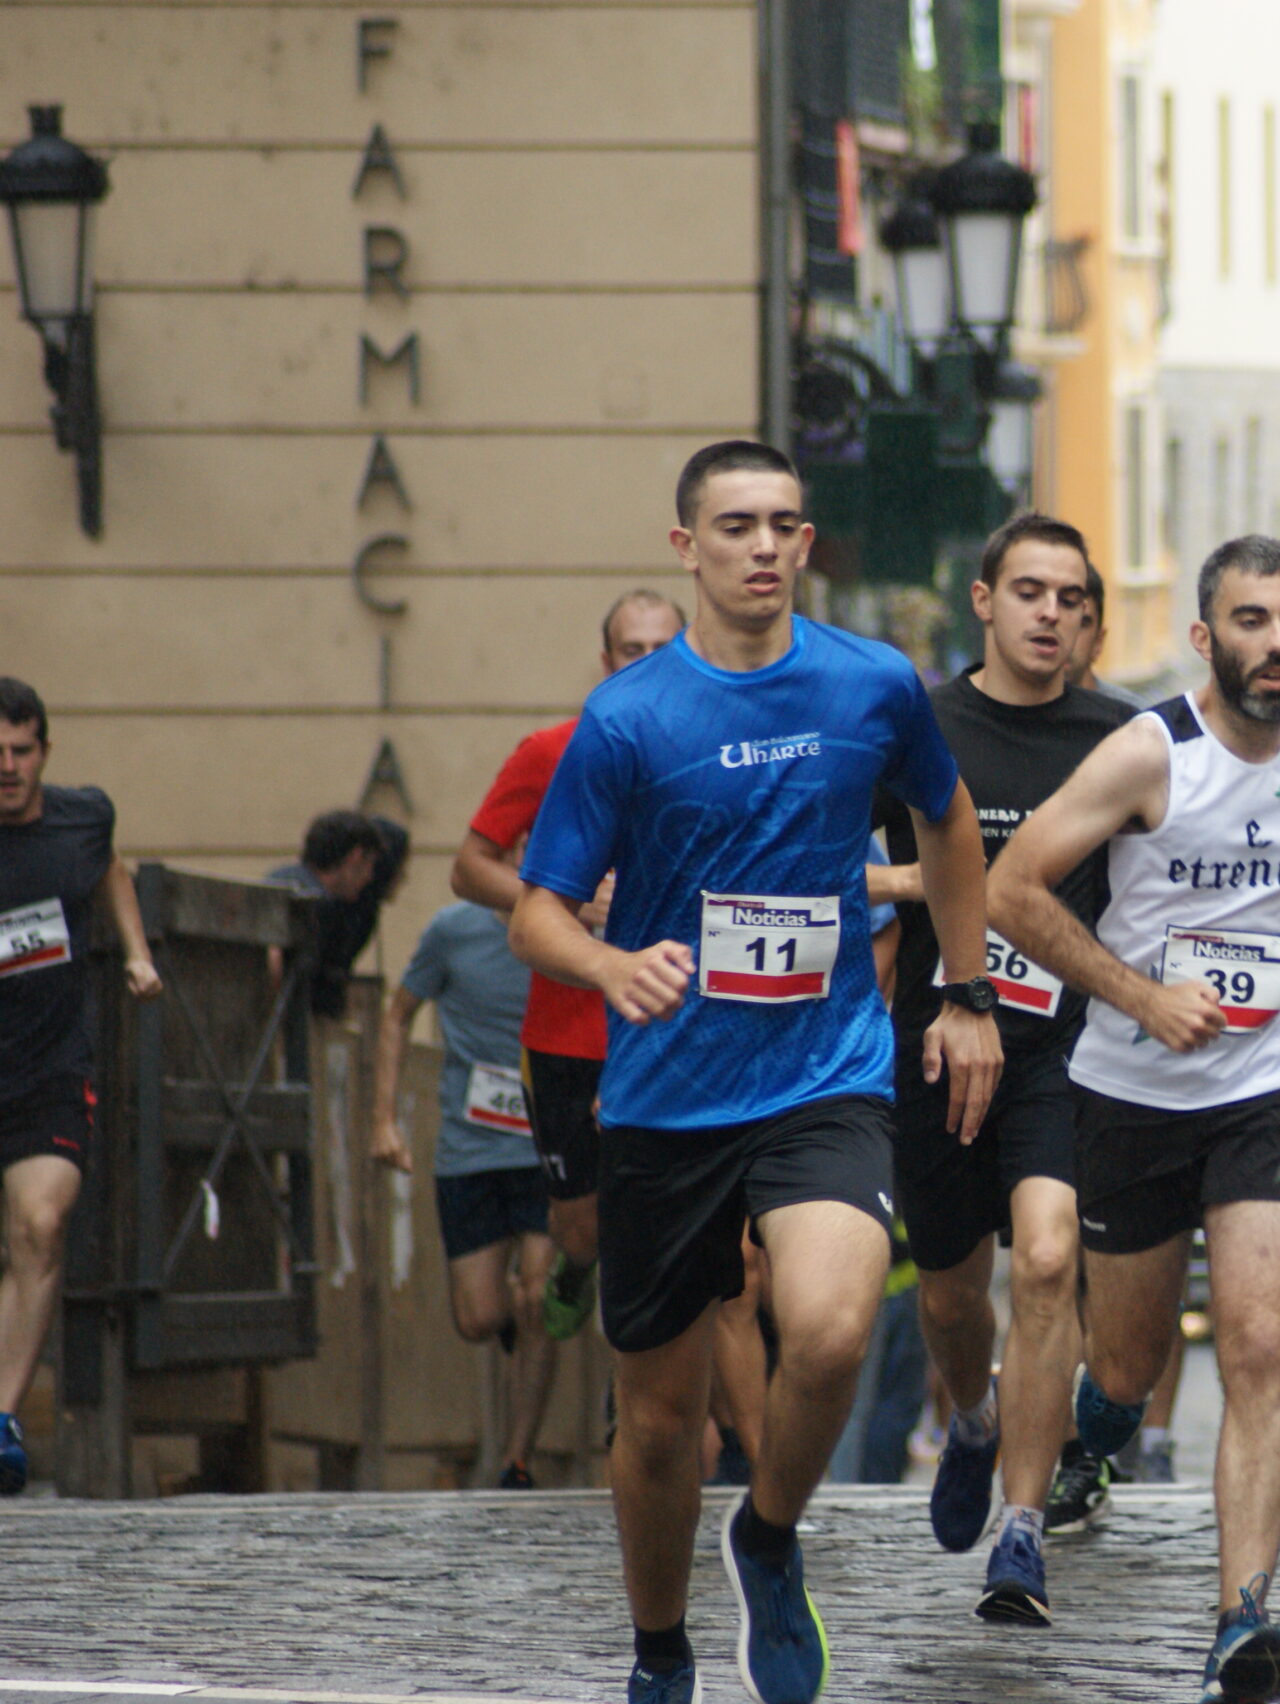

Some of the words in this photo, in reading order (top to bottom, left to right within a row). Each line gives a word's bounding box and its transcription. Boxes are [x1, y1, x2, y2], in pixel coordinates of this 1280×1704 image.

[352, 19, 421, 815] FARMACIA
[735, 908, 808, 926] Noticias
[745, 936, 797, 972] 11
[986, 942, 1028, 980] 56
[1196, 942, 1262, 961] Noticias
[1204, 968, 1255, 1003] 39
